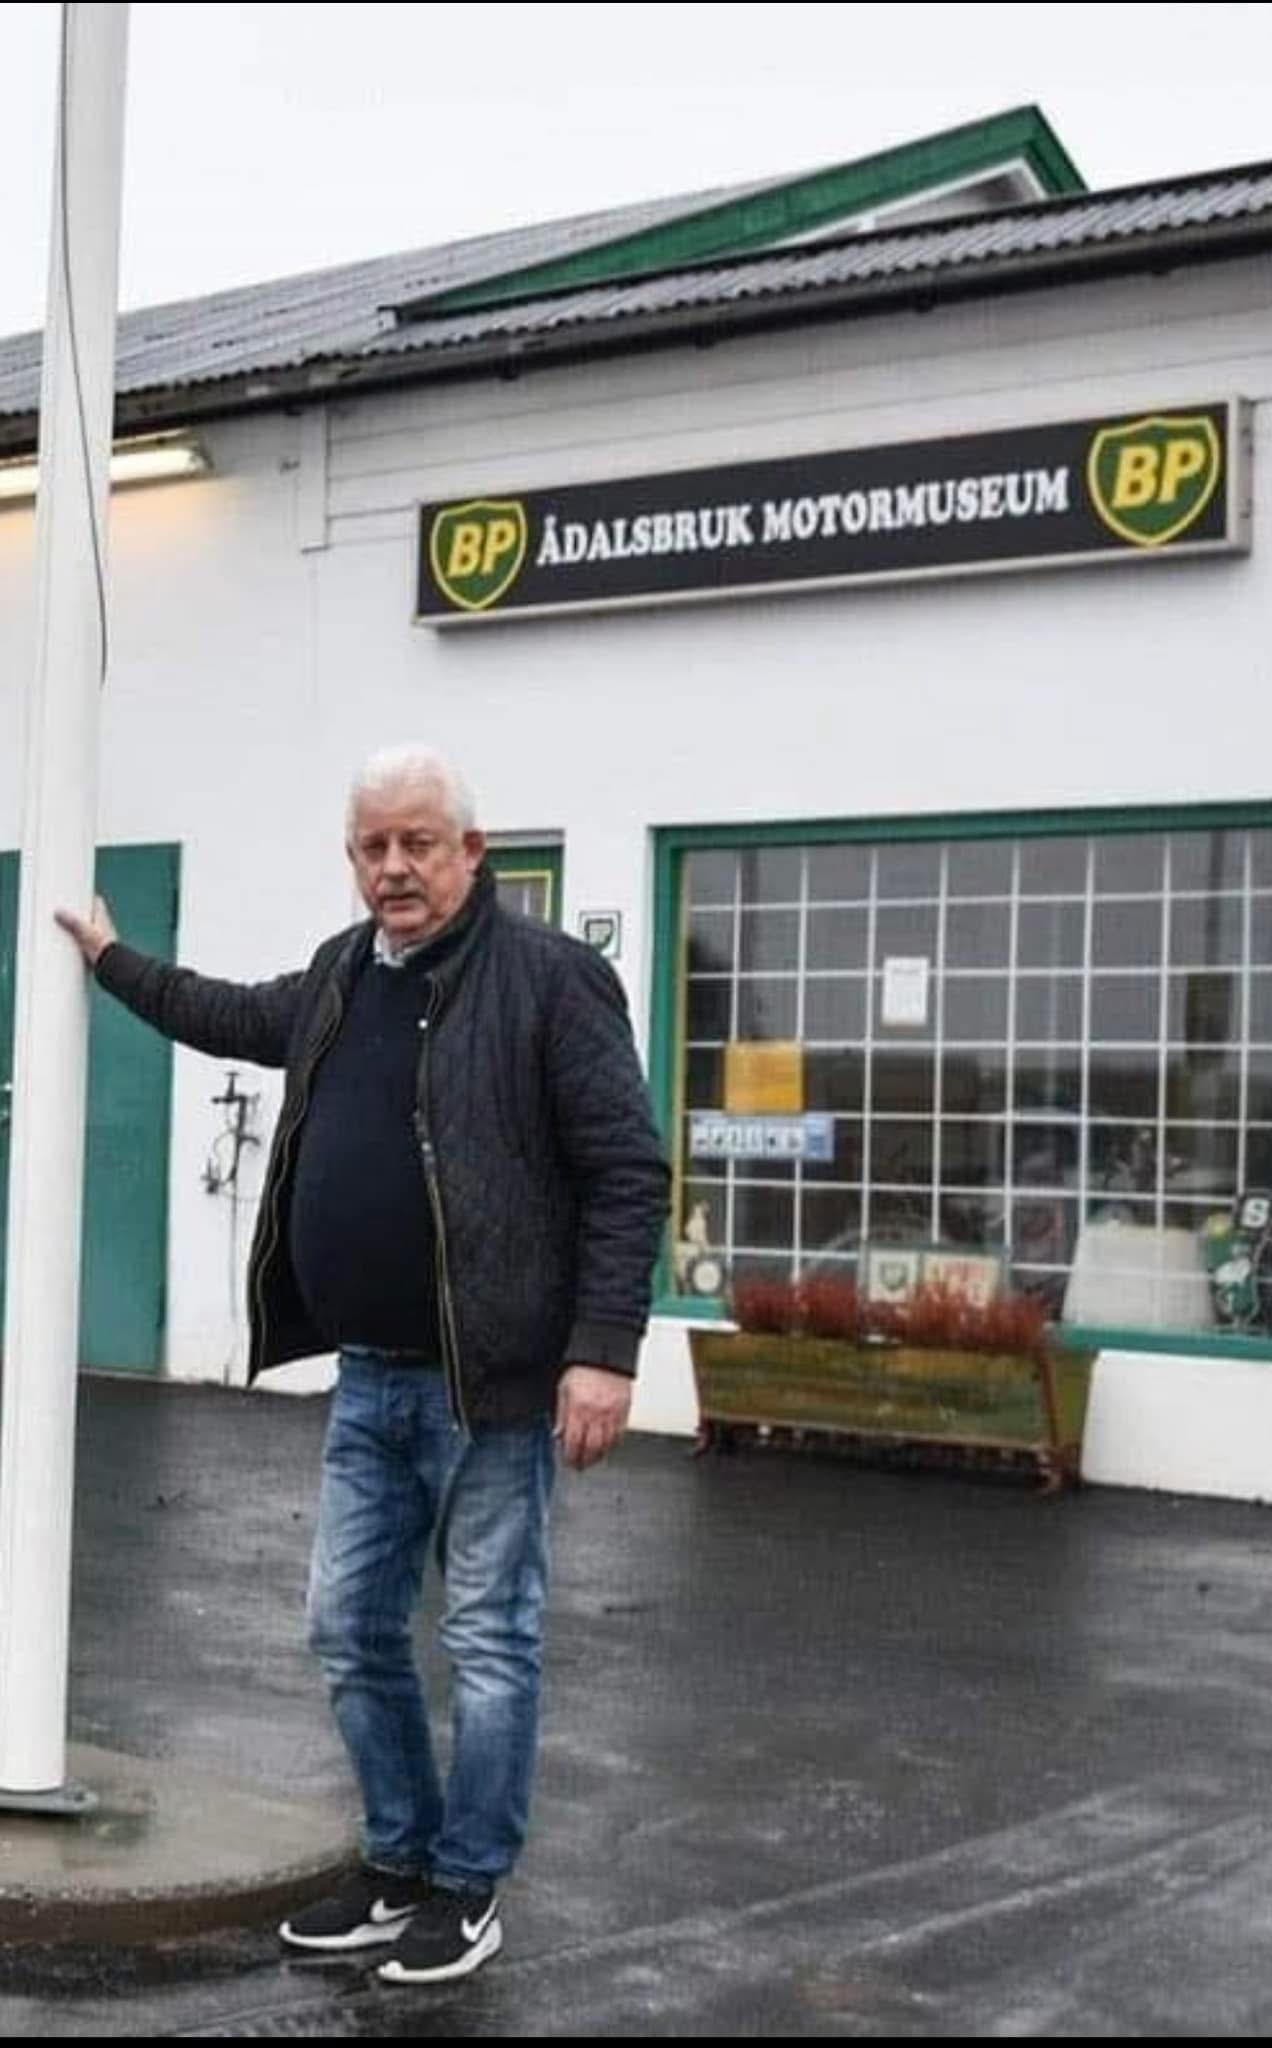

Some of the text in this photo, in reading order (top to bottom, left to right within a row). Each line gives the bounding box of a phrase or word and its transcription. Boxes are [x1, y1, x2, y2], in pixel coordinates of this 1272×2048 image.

[446, 438, 1205, 578] BP ÅDALSBRUK MOTORMUSEUM BP
